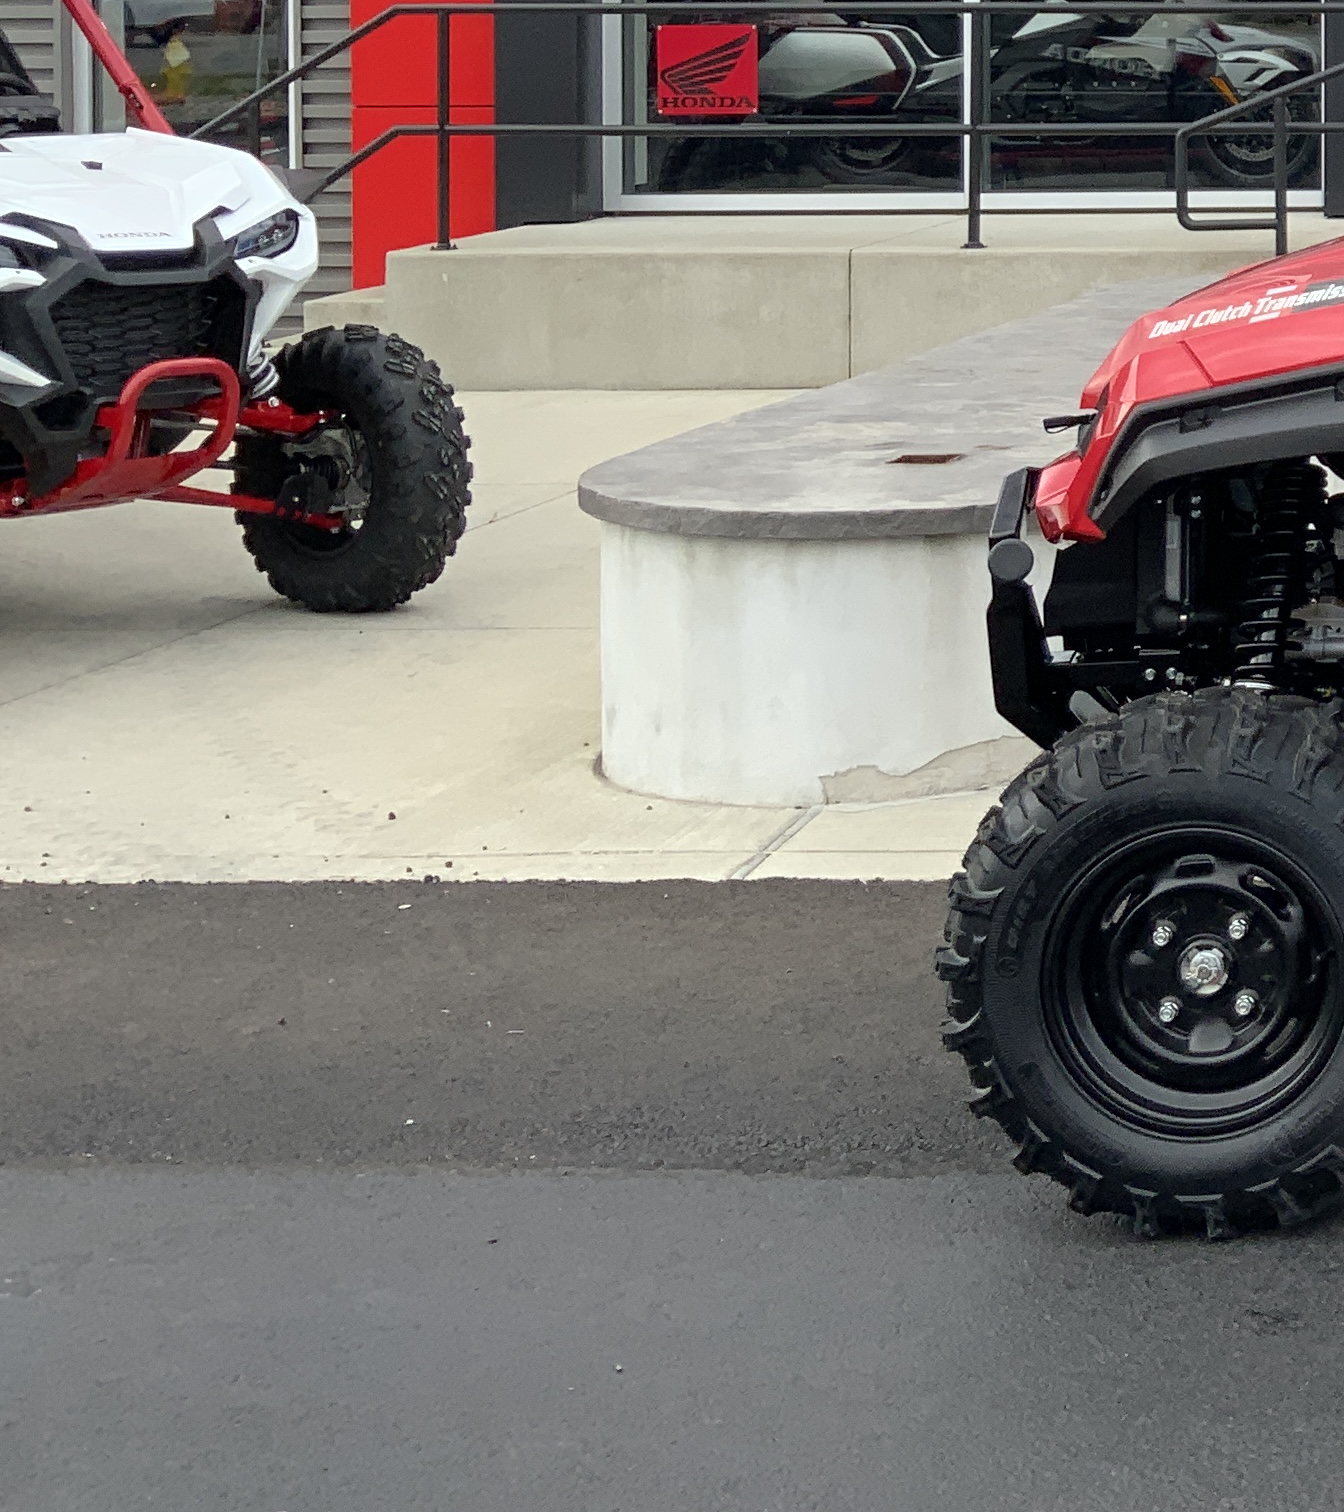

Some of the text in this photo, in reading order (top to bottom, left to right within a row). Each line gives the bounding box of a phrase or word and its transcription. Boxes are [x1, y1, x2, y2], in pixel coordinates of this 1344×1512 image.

[661, 96, 756, 108] HONDA
[96, 231, 174, 239] HONDA
[1149, 316, 1191, 339] Dual
[1193, 302, 1253, 328] Clutch
